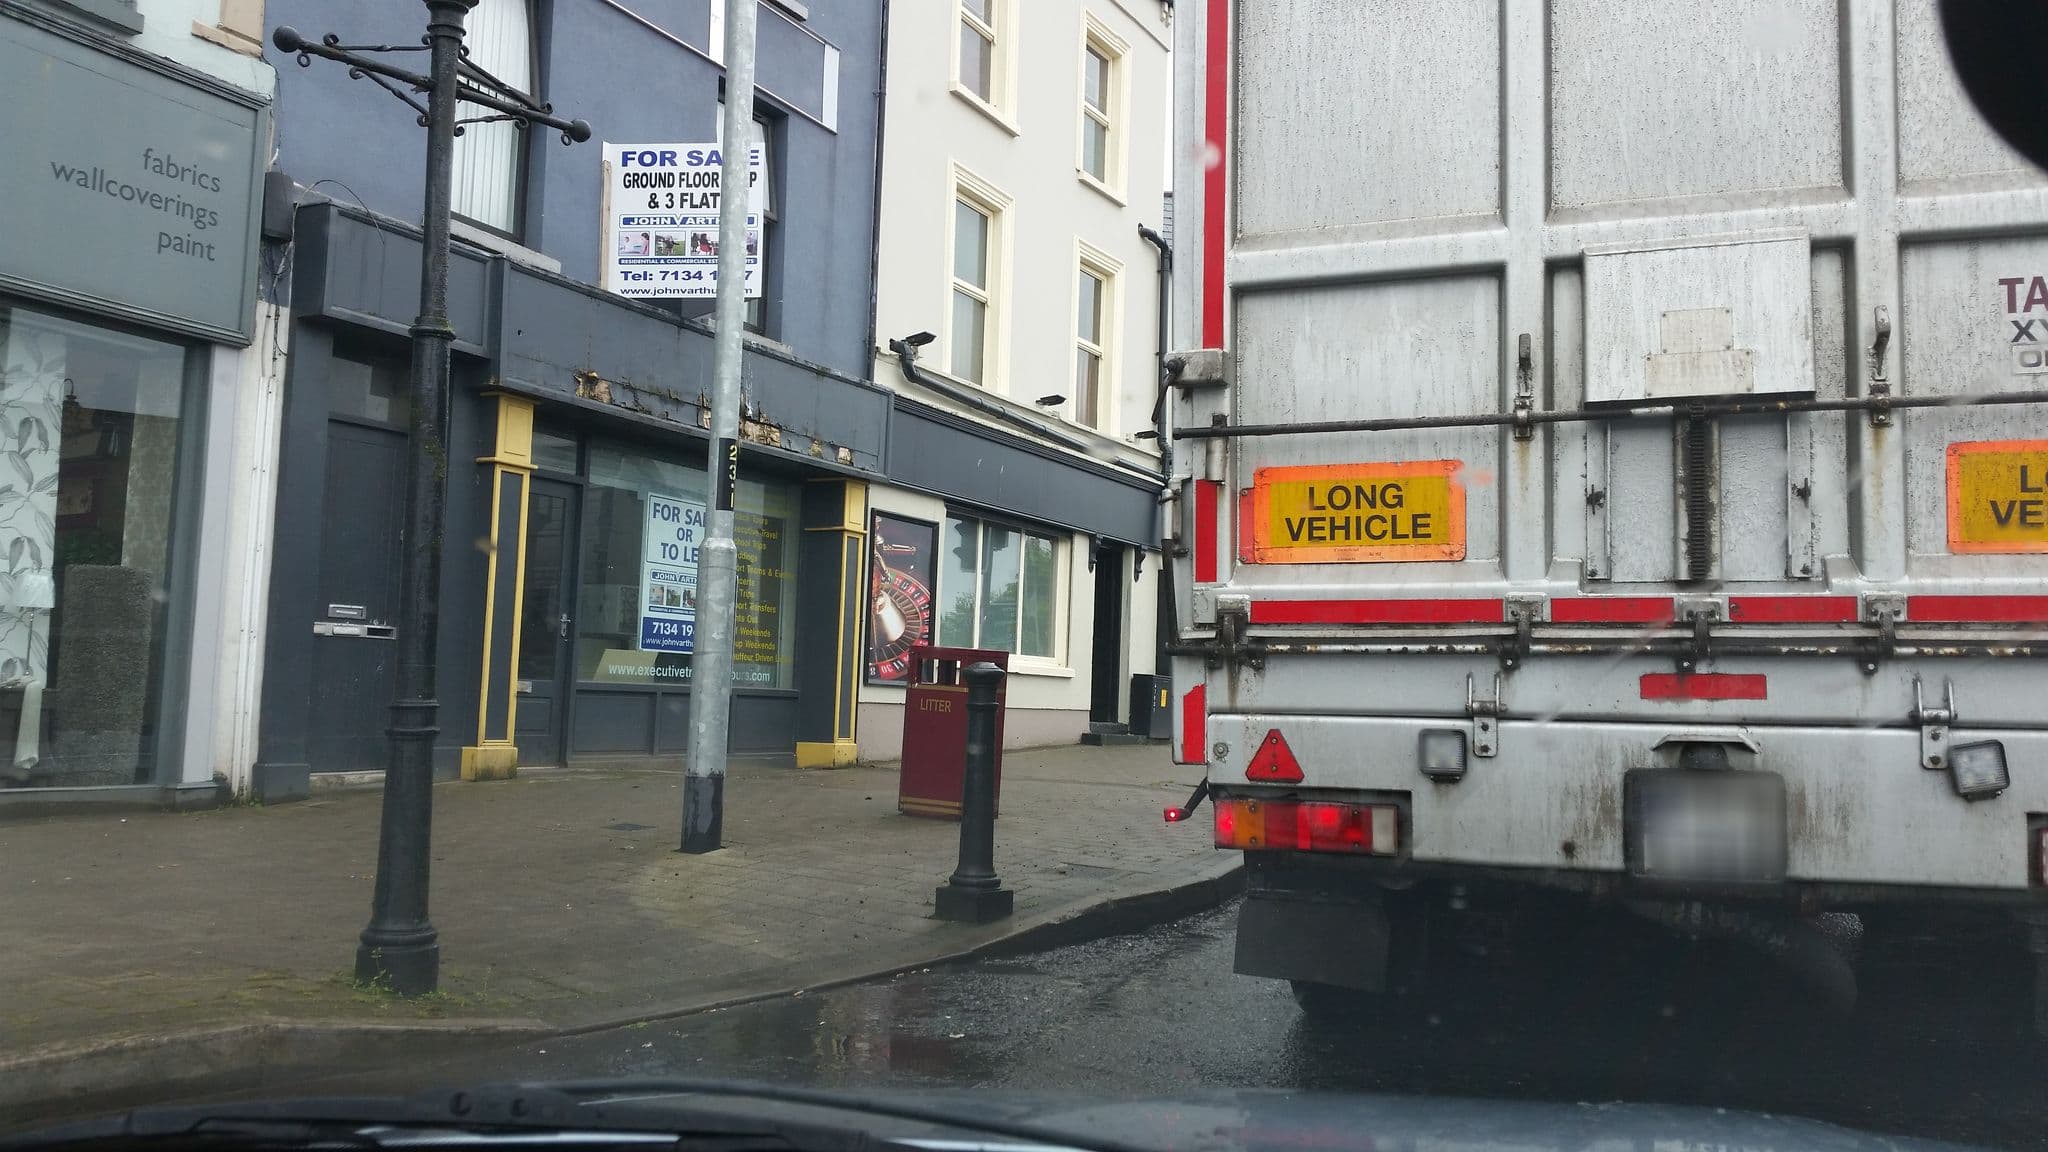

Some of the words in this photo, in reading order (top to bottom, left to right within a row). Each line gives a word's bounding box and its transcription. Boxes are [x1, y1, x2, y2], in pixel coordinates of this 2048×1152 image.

[621, 150, 678, 167] FOR
[686, 150, 760, 166] SAE
[143, 148, 220, 193] fabrics
[623, 172, 676, 189] GROUND
[678, 171, 720, 189] FLOOR
[50, 161, 218, 230] wallcoverings
[647, 193, 660, 209] &
[664, 193, 675, 209] 3
[679, 192, 721, 209] FLAT
[629, 217, 671, 226] JOHN
[157, 232, 216, 262] paint
[620, 270, 653, 281] Tel:
[660, 270, 703, 281] 7134
[1308, 483, 1404, 511] LONG
[652, 502, 680, 523] FOR
[1989, 500, 2048, 528] VE
[676, 527, 693, 543] OR
[1285, 513, 1433, 542] VEHICLE
[660, 542, 679, 561] TO
[683, 546, 699, 563] LE
[655, 572, 675, 581] JOHN
[652, 621, 678, 636] 7134
[919, 697, 952, 713] LITTER
